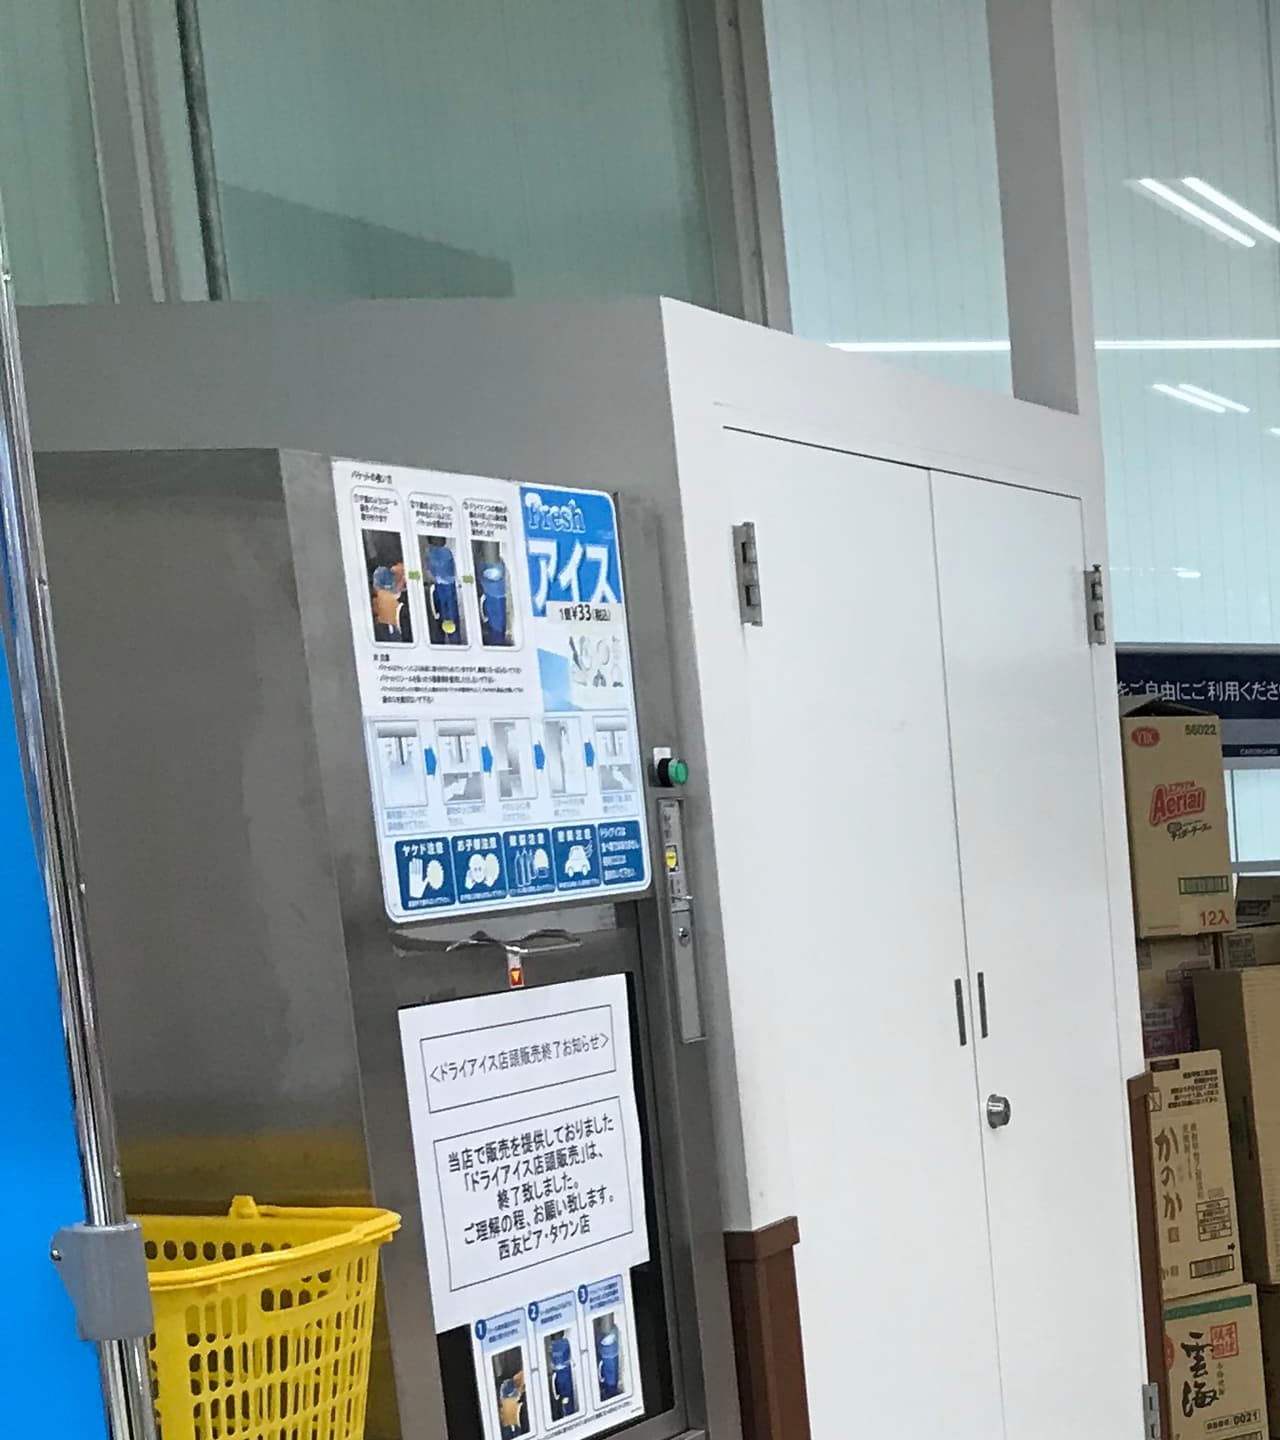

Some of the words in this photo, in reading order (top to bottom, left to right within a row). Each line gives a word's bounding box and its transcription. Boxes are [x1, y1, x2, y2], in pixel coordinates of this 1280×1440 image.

[524, 492, 587, 533] Fresh
[527, 537, 618, 612] アイス
[1152, 785, 1206, 825] Aerial
[448, 1113, 614, 1173] 当店で販売を提供しておりました
[464, 1185, 614, 1245] ご理解の程、お願い致します。
[497, 1172, 579, 1210] 終了致しました。
